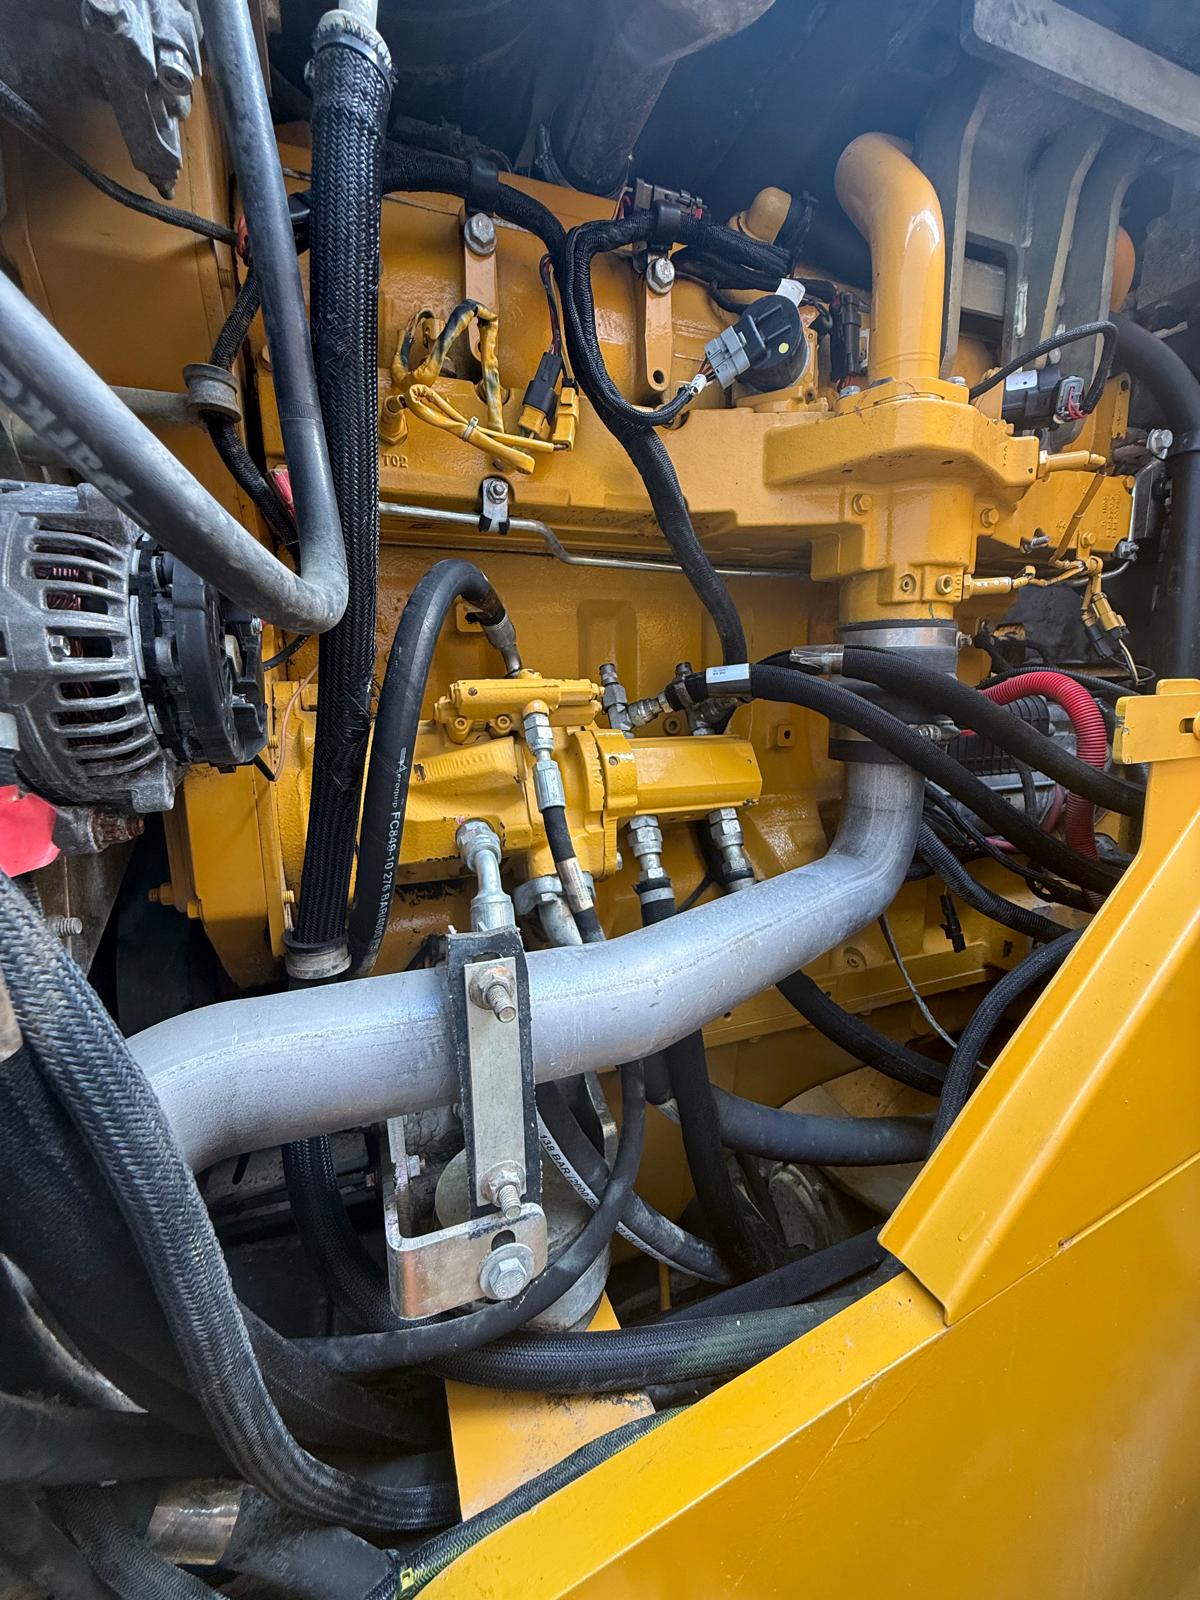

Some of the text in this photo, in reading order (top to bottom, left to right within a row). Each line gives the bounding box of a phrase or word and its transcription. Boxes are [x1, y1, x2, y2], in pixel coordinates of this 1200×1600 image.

[0, 361, 134, 498] Parke
[384, 811, 401, 869] FC849-10
[381, 871, 393, 892] 276
[540, 1134, 555, 1152] 138
[553, 1153, 571, 1174] BAR
